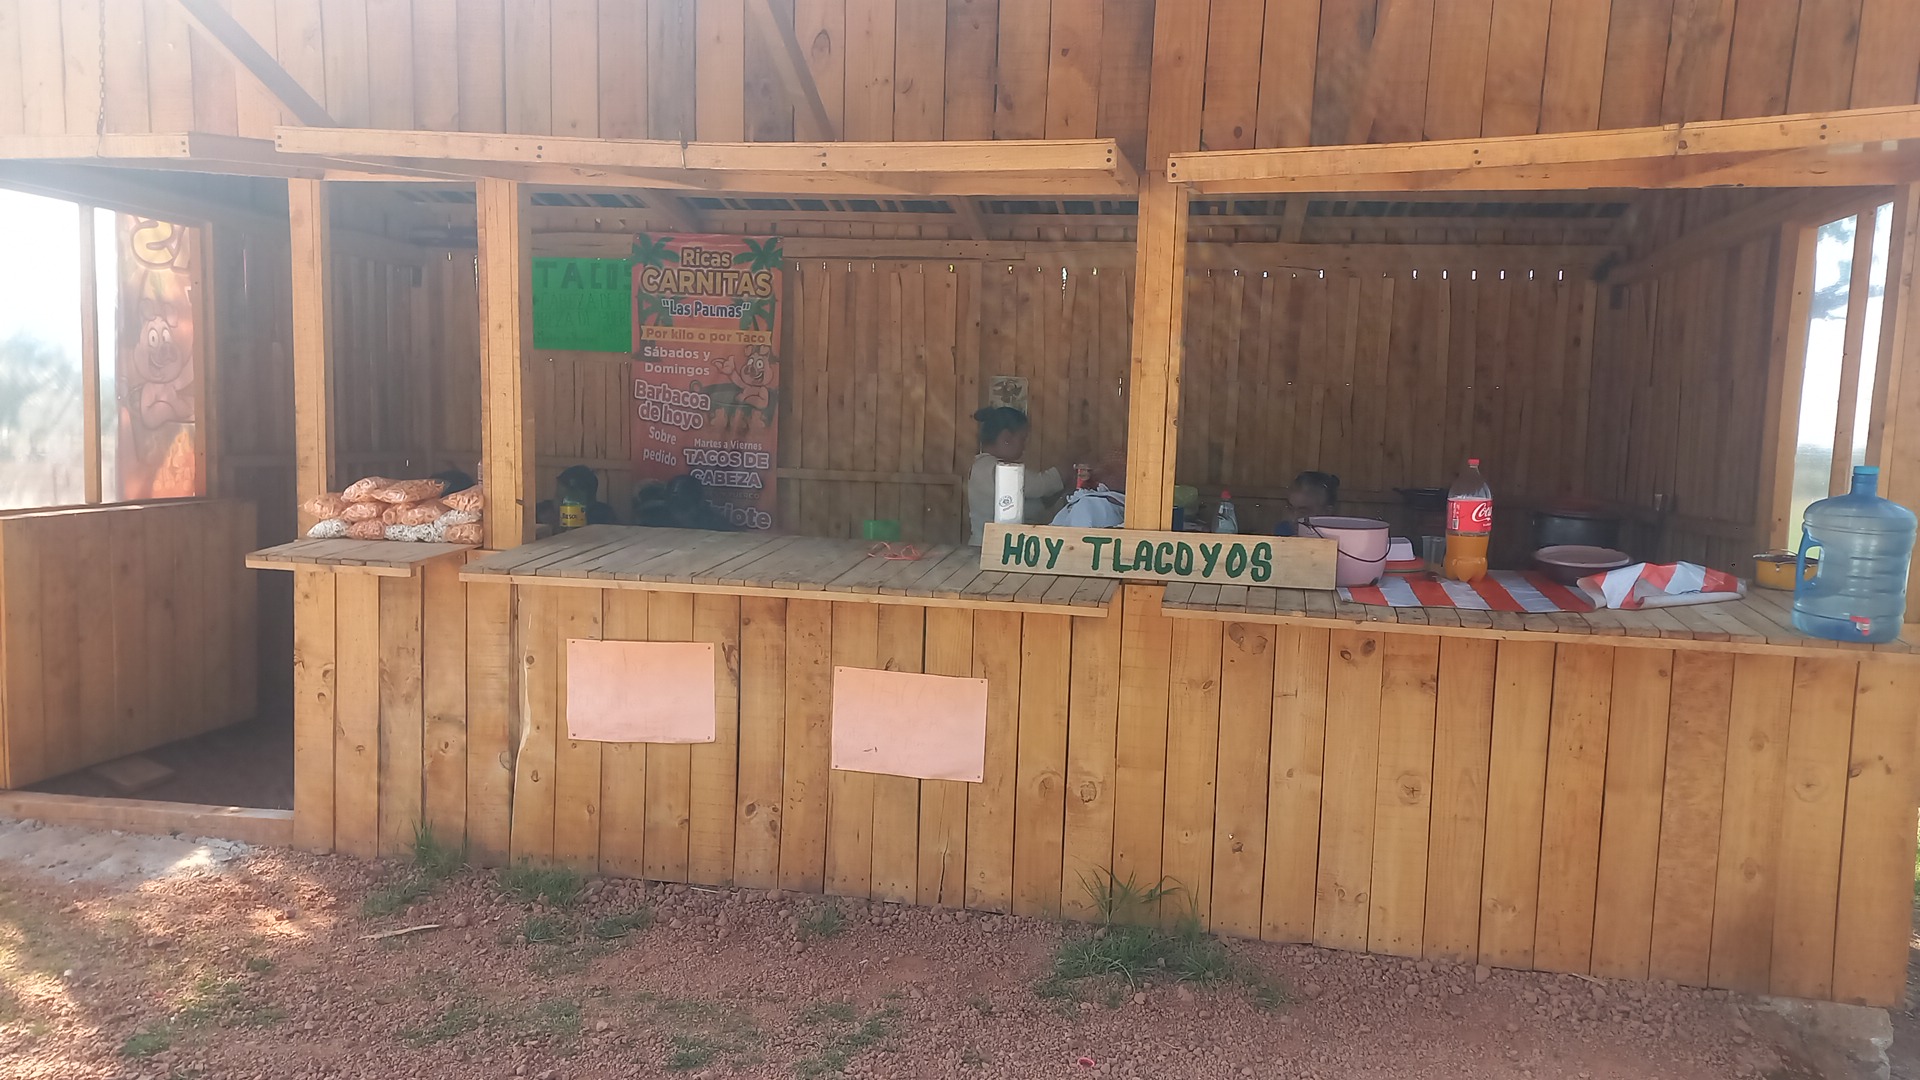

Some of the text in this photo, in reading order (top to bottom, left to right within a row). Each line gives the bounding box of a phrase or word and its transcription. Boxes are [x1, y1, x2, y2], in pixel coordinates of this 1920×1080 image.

[681, 247, 732, 268] Ricas
[641, 267, 773, 298] CARNITAS
[646, 328, 765, 343] Por kilo o por Taco
[644, 346, 710, 361] Sábados y
[644, 362, 710, 376] Domingos
[635, 379, 711, 411] Barbacoa
[638, 401, 704, 430] de hoyo
[649, 426, 677, 445] Sobre
[694, 438, 721, 449] Martes
[730, 440, 762, 451] Viernes
[683, 449, 769, 469] TACOS DE
[690, 468, 762, 489] CABEZA
[1001, 532, 1272, 582] HOY TLACOYOS
